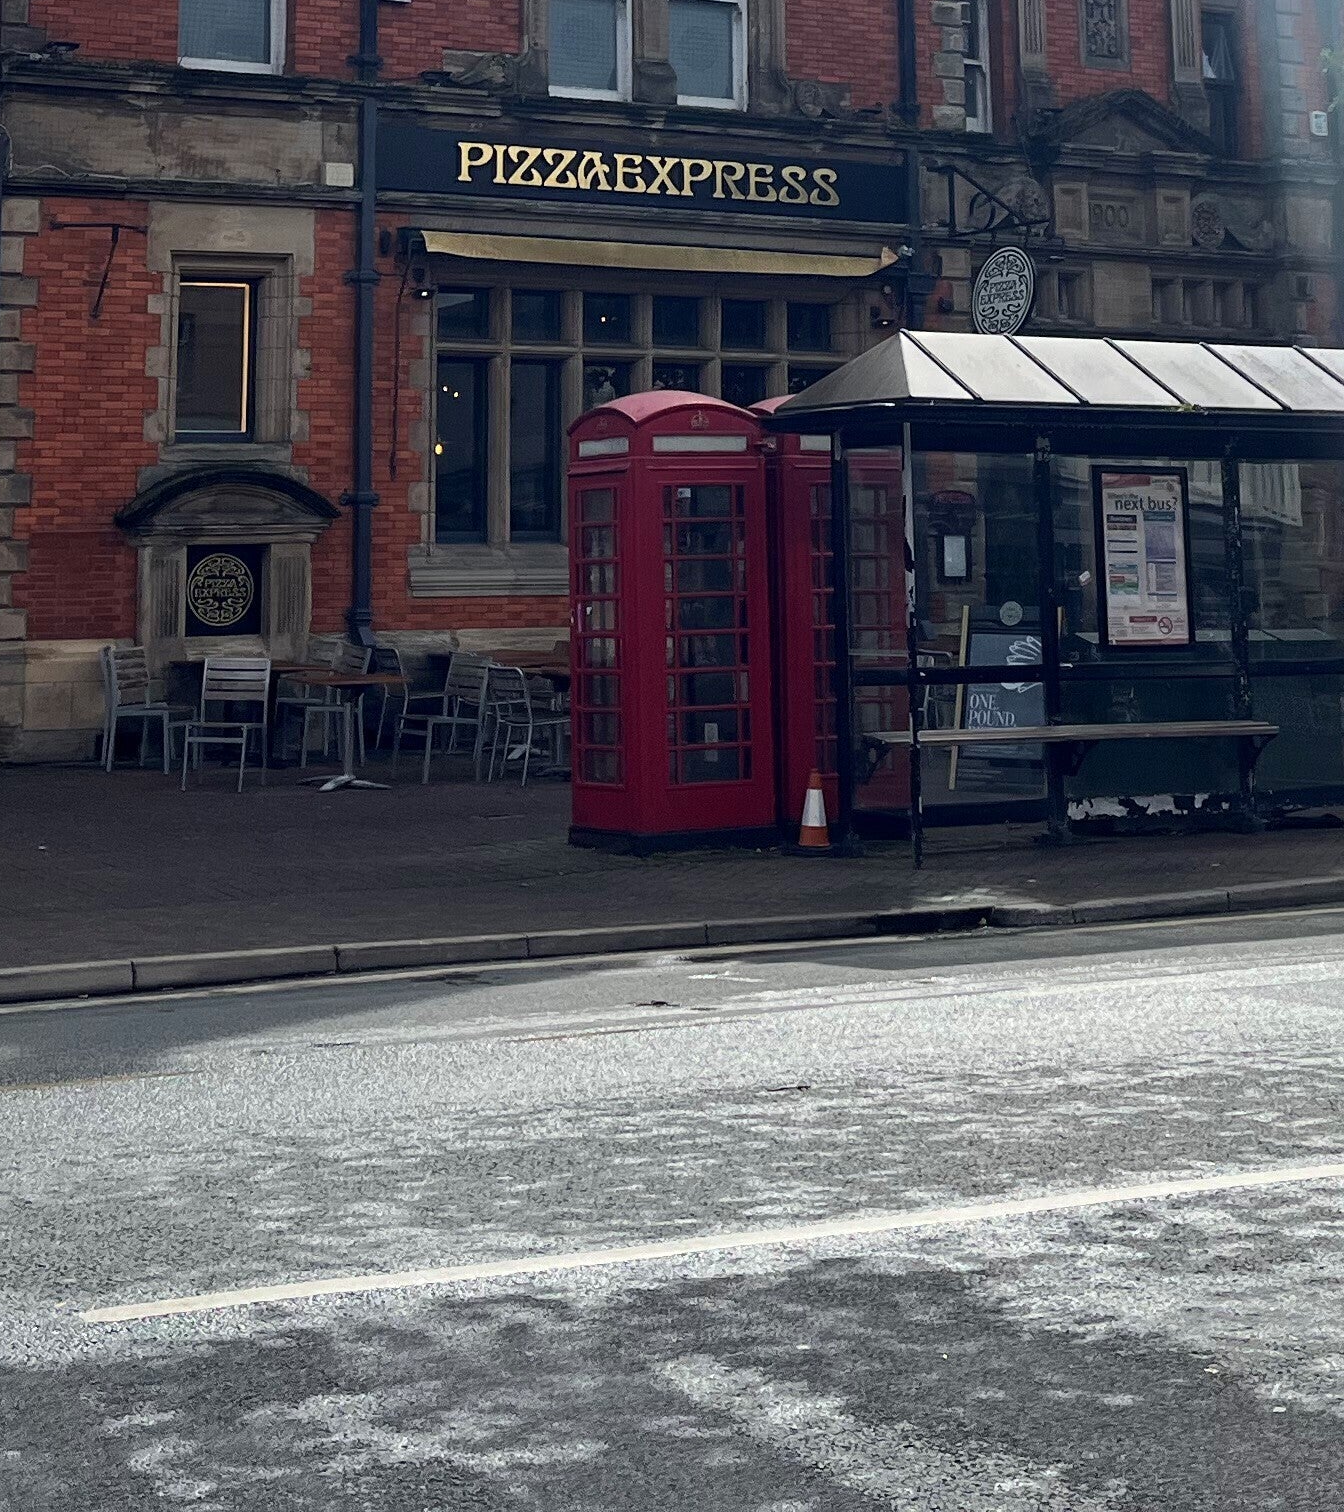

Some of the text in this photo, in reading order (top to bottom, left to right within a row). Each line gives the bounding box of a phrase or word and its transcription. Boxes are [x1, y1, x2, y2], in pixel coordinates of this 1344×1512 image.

[989, 279, 1018, 293] PIZZA
[980, 289, 1025, 305] EXPRESS
[1114, 495, 1179, 512] next bus?
[205, 578, 237, 589] PIZZA
[194, 587, 247, 598] EXPRESS
